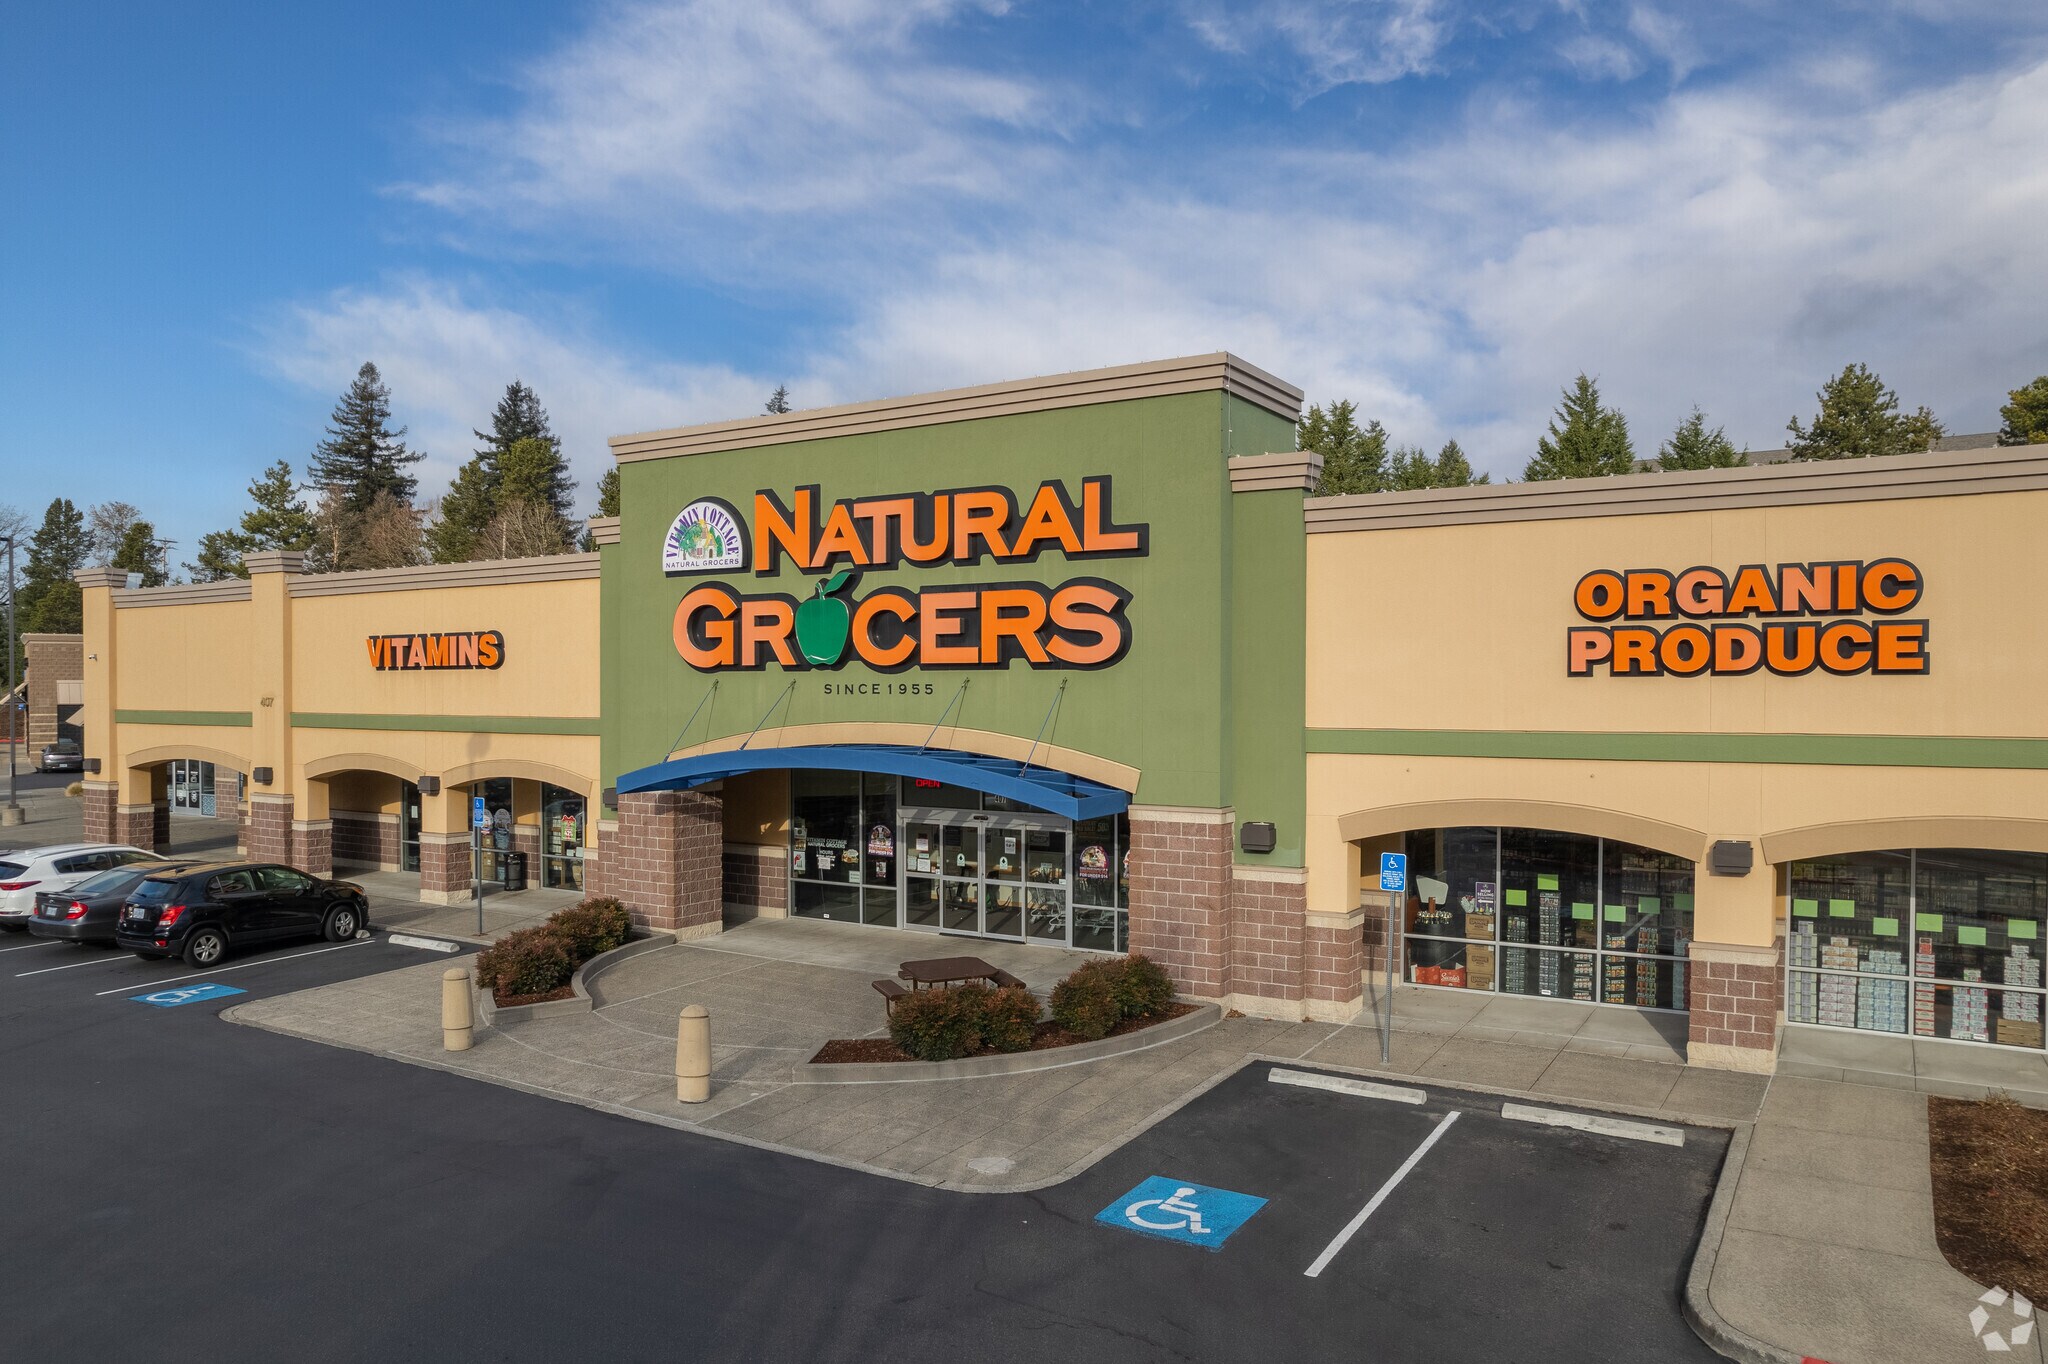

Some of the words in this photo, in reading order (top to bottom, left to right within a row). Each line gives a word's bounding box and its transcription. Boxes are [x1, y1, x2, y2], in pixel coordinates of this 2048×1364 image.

[666, 506, 701, 558] VITAMIN
[703, 506, 739, 556] COTTAGE
[755, 481, 1141, 572] NATURAL
[665, 560, 700, 568] NATURAL
[702, 558, 739, 567] GROCERS
[1575, 561, 1918, 618] ORGANIC
[672, 584, 1123, 666] GROCERS
[366, 633, 499, 668] VITAMINS
[1570, 623, 1924, 673] PRODUCE
[260, 696, 275, 707] 407
[824, 683, 881, 695] SINCE
[888, 683, 934, 695] 1955
[915, 779, 941, 788] OPEN
